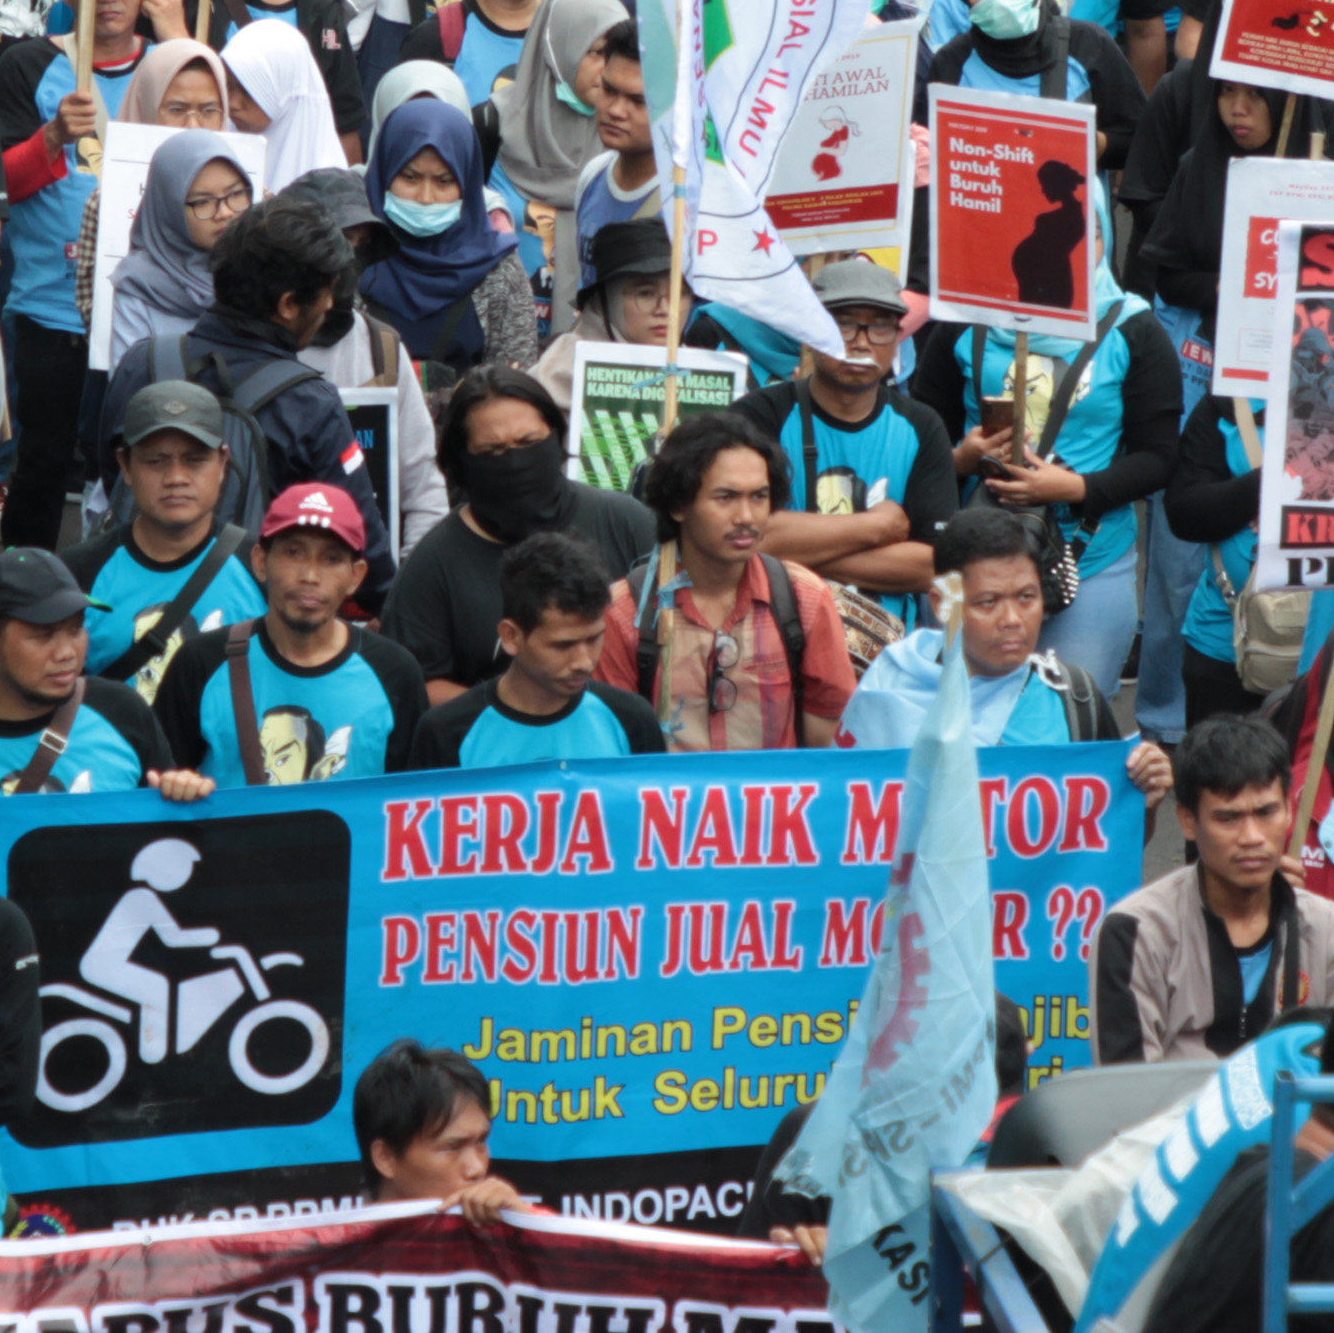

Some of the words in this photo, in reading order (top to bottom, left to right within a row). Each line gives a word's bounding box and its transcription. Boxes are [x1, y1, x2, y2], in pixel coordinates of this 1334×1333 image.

[830, 67, 886, 86] AWAL
[736, 67, 789, 159] ILMU
[949, 137, 1035, 165] Non-Shift
[949, 158, 1000, 178] untuk
[950, 173, 1003, 196] Buruh
[950, 191, 1001, 213] Hamil
[587, 382, 640, 400] KARENA
[686, 375, 731, 390] MASAL
[379, 790, 613, 882] KERJA
[636, 785, 819, 871] NAIK
[839, 775, 1111, 865] MTOR
[378, 904, 643, 988] PENSIUN
[661, 898, 804, 977] JUAL
[463, 1015, 692, 1065] Jaminan
